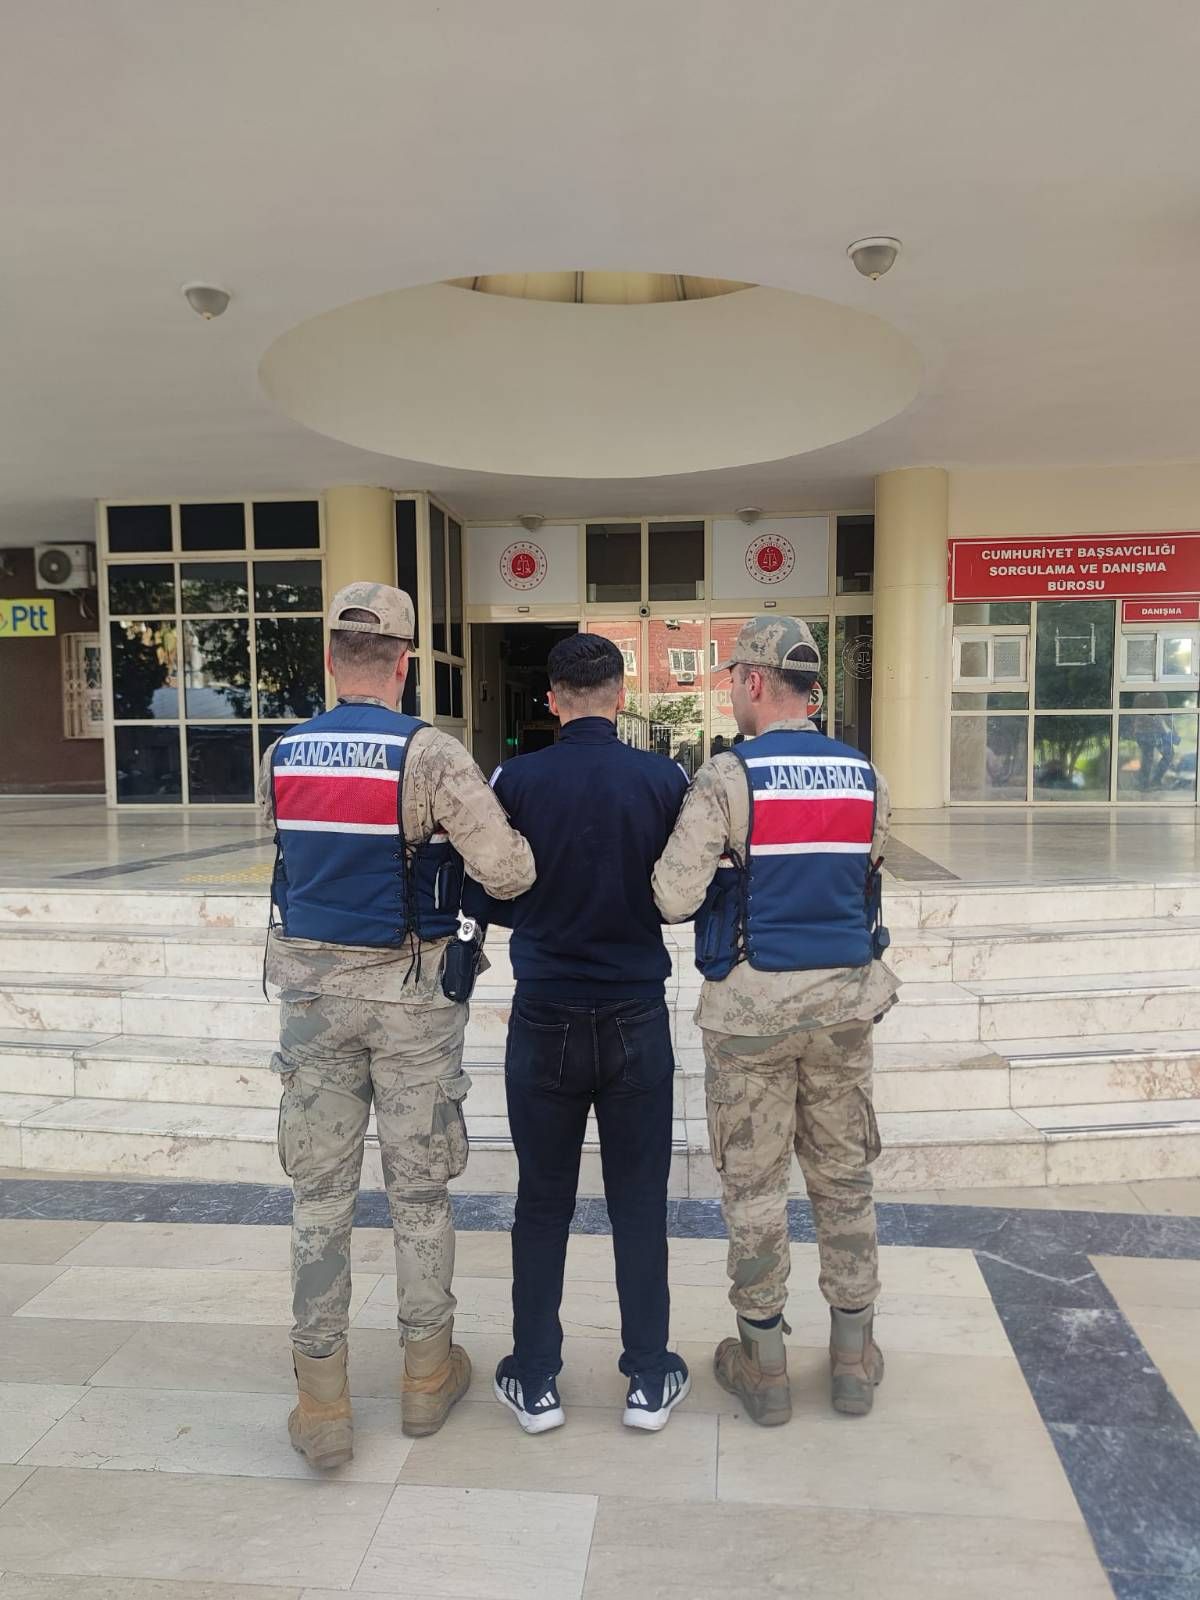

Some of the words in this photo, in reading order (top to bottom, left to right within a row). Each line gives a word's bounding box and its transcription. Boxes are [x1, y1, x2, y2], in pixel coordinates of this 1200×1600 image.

[981, 546, 1073, 560] CUMHURİYET
[1077, 544, 1176, 559] BAŞSAVCILIĞI
[989, 564, 1076, 577] SORGULAMA
[1080, 564, 1098, 575] VE
[1102, 561, 1167, 575] DANIŞMA
[1047, 579, 1105, 592] BÜROSU
[12, 606, 49, 631] Ptt
[1141, 607, 1182, 616] DANIŞMA
[284, 741, 388, 769] JANDARMA
[765, 765, 867, 790] JANDARMA
